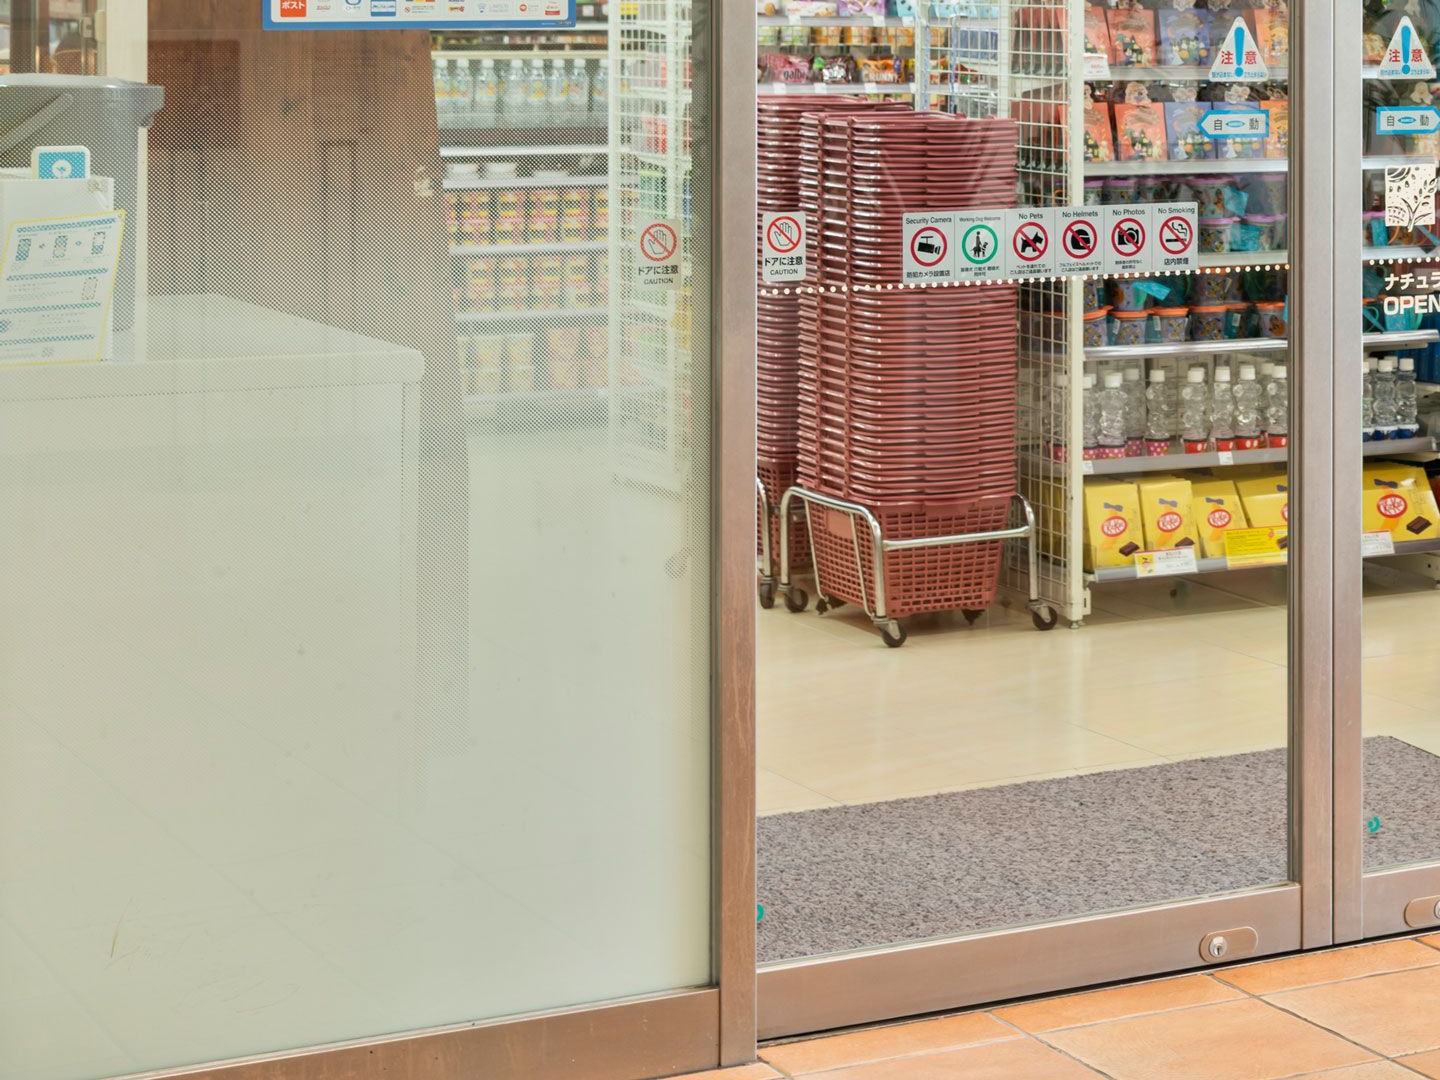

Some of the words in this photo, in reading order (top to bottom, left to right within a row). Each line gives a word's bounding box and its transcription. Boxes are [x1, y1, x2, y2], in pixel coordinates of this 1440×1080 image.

[282, 1, 305, 9] ポスト
[1221, 51, 1234, 65] 注
[1244, 51, 1257, 65] 意
[1388, 49, 1400, 63] 注
[1411, 48, 1423, 62] 意
[1214, 118, 1222, 131] 自
[1249, 117, 1259, 131] 動
[1386, 115, 1395, 128] 自
[1420, 114, 1429, 127] 動
[765, 256, 803, 266] ドアに注意
[1164, 257, 1189, 265] 店内禁煙
[638, 264, 679, 275] ドアに注意
[770, 268, 798, 276] CAUTION
[906, 270, 950, 278] 防犯カメラ設置店
